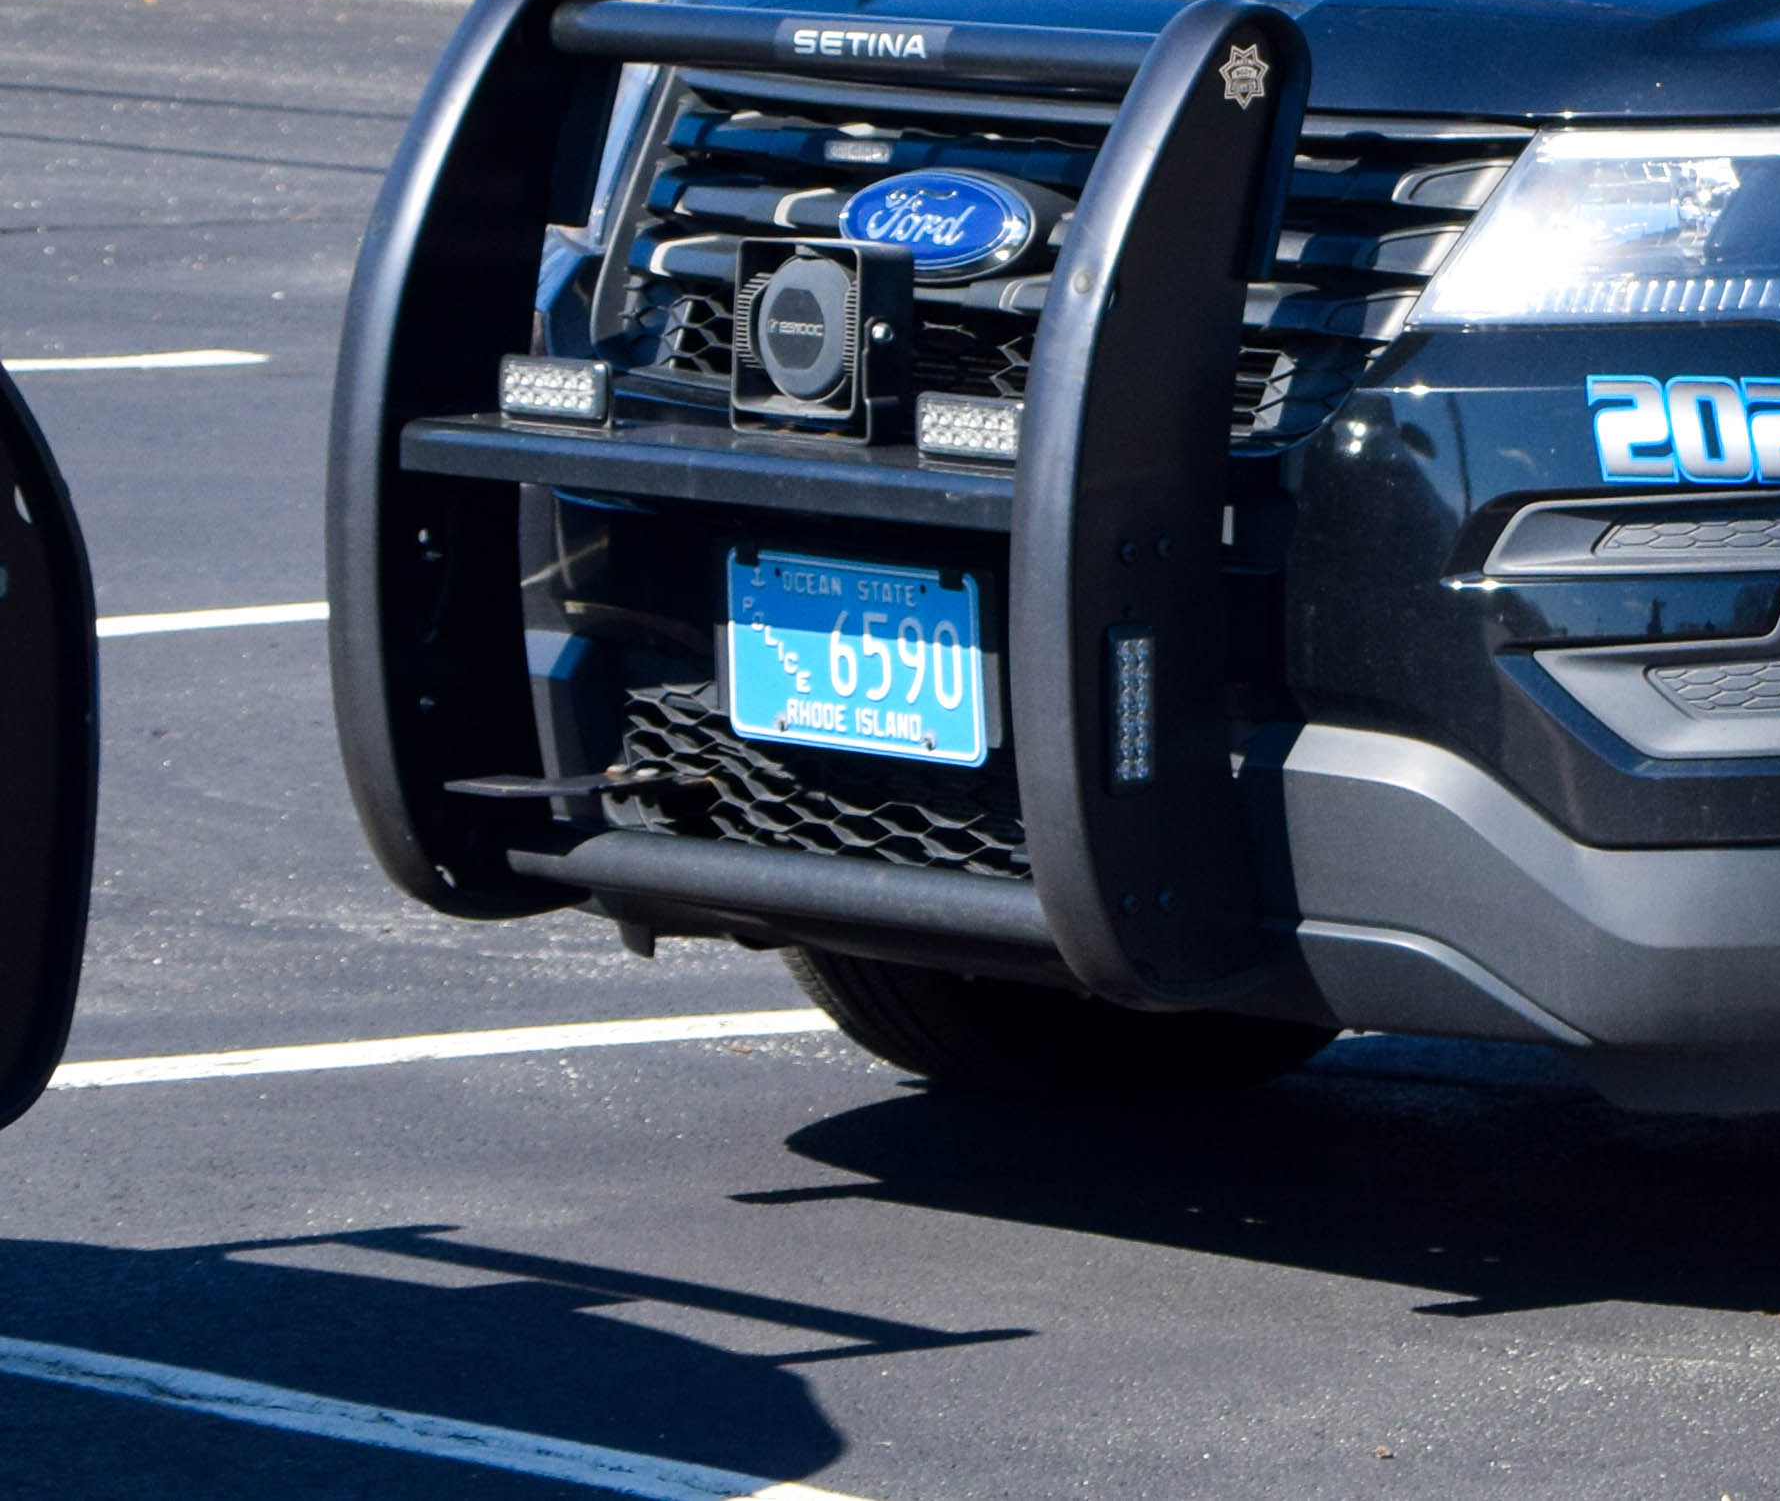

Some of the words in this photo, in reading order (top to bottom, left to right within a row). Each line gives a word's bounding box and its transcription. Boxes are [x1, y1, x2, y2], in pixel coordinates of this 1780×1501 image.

[793, 29, 928, 59] SETINA
[866, 190, 977, 246] Ford
[782, 570, 843, 597] OCEAN
[857, 579, 917, 607] STATE
[742, 596, 812, 694] POLICE
[829, 610, 963, 710] 6590
[786, 699, 847, 731] RHODE
[855, 708, 923, 742] ISLAND
